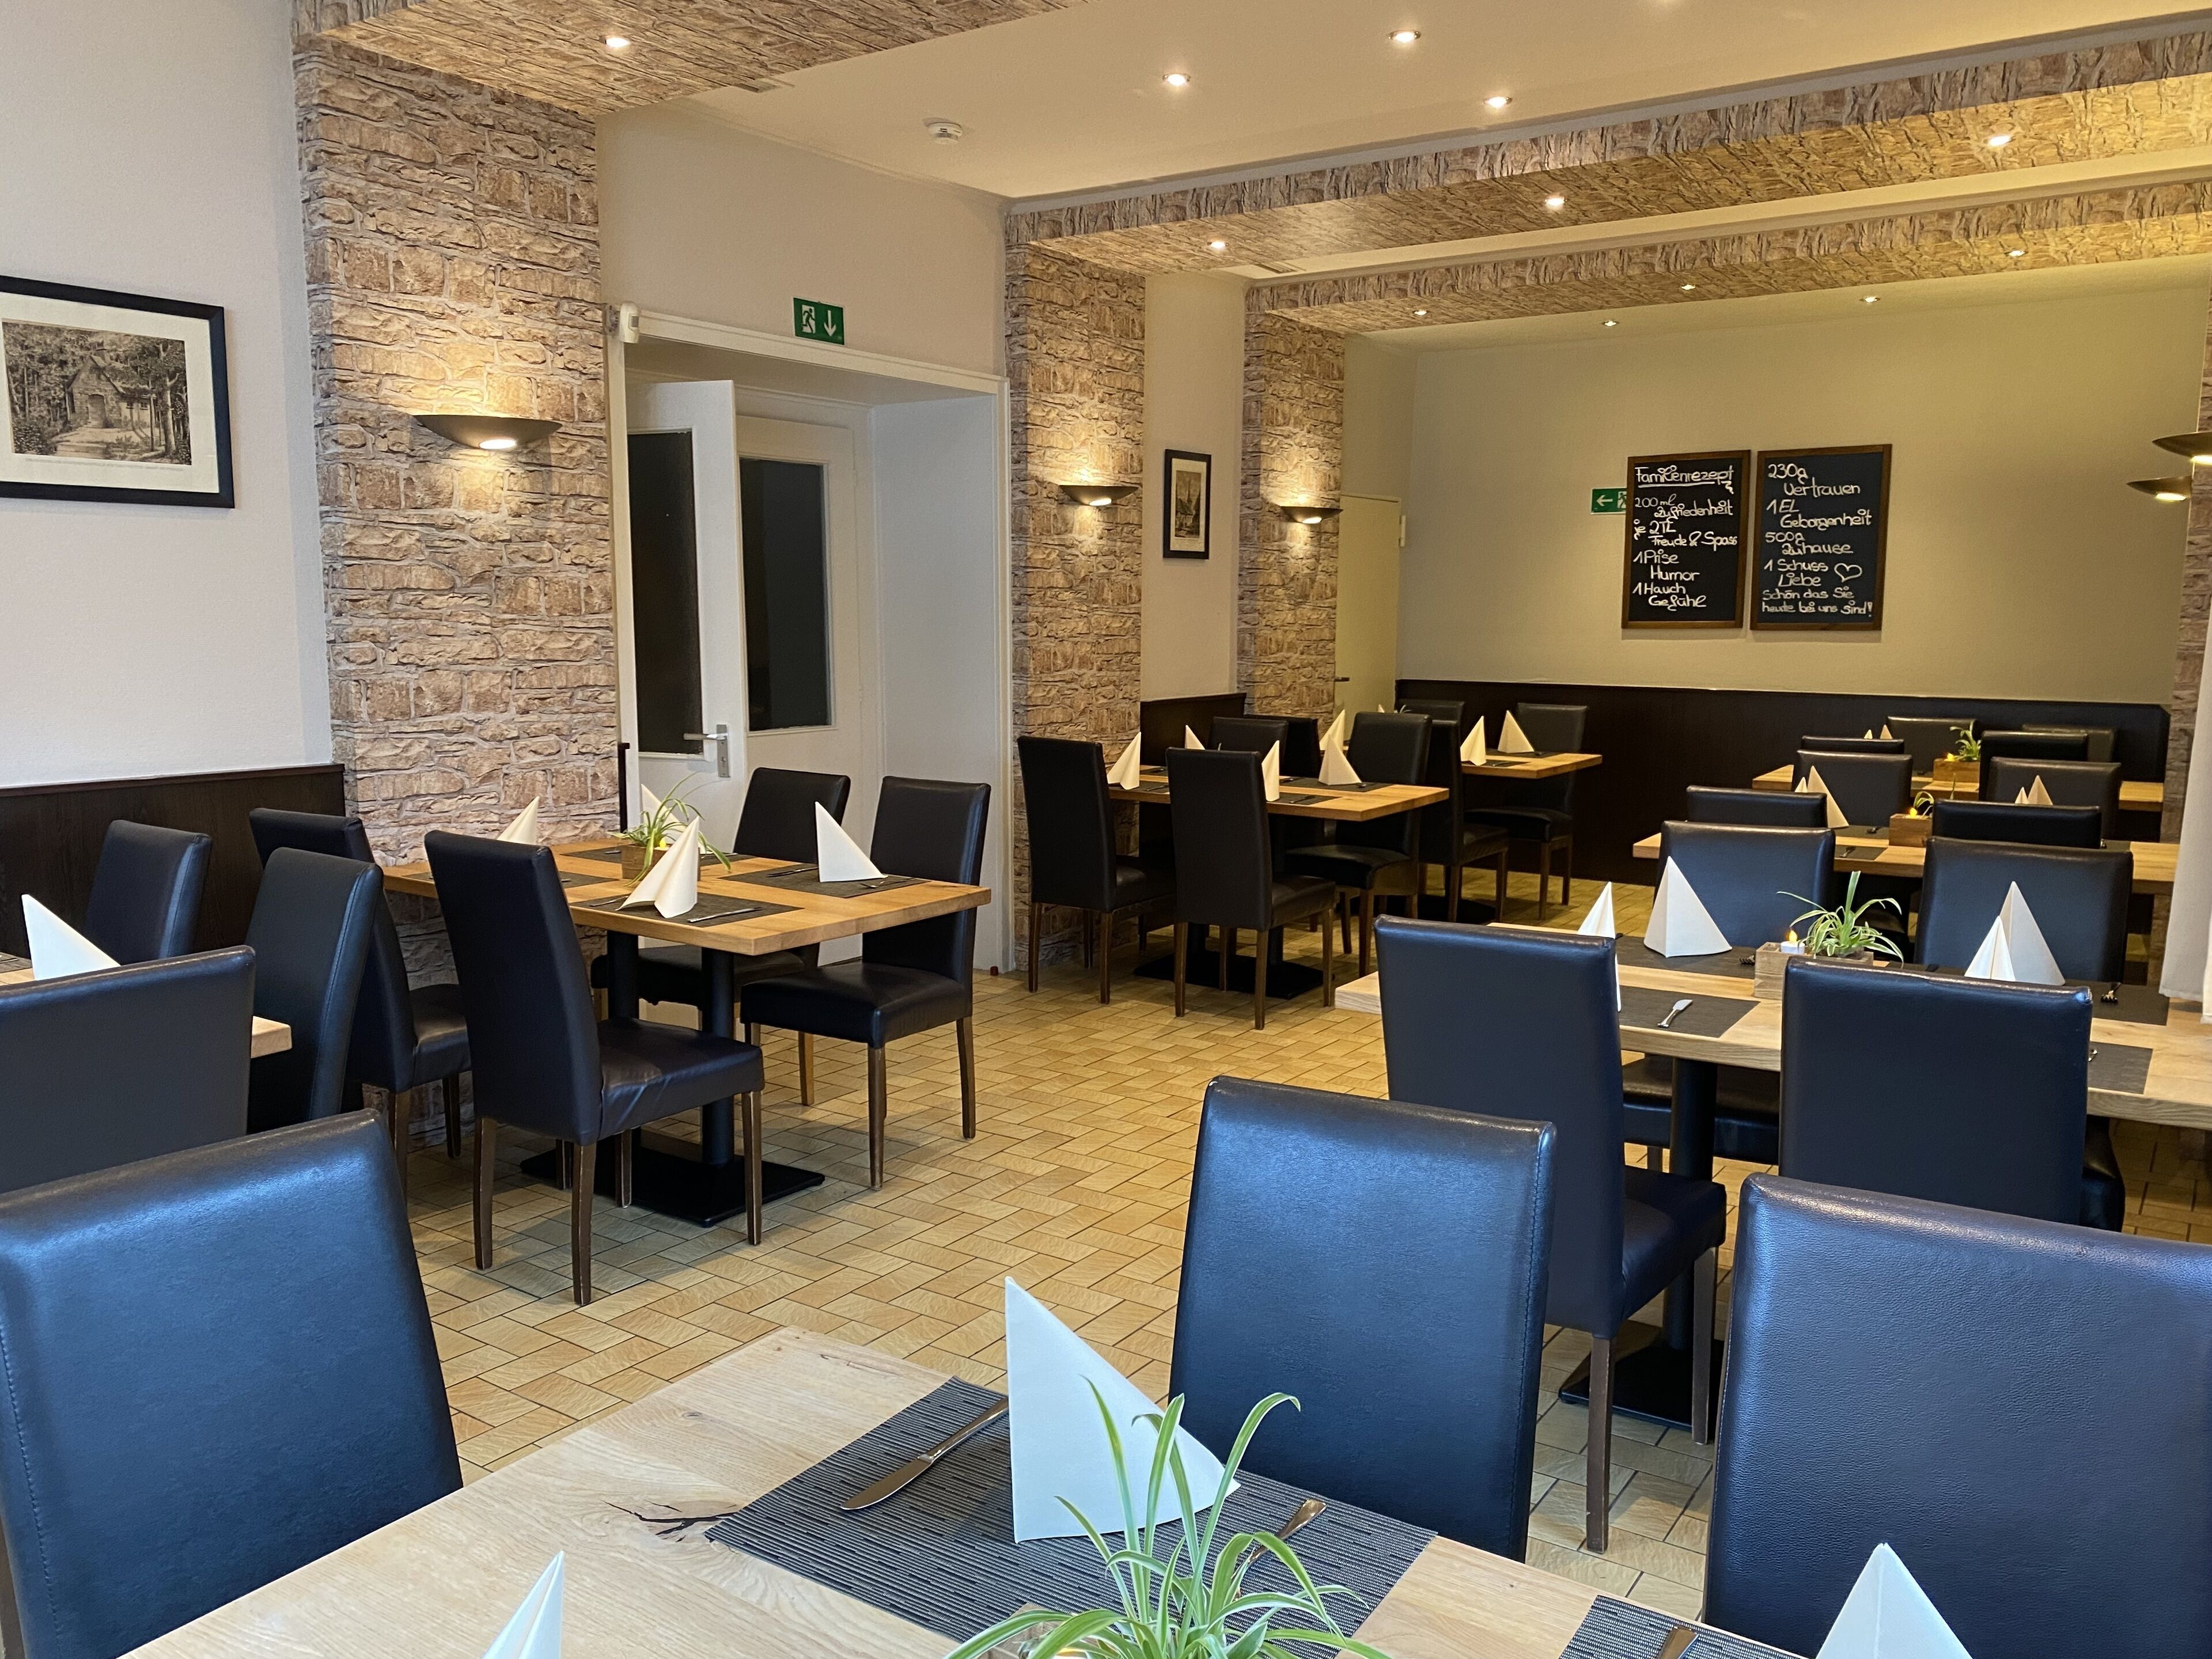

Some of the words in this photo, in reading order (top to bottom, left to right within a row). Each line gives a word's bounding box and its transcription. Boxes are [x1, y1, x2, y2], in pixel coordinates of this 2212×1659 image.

[1635, 465, 1734, 485] Familienrezept
[1768, 463, 1808, 484] 230g
[1635, 497, 1658, 507] 200
[1660, 493, 1676, 506] ml
[1654, 499, 1733, 519] Zufriedenheit
[1781, 509, 1872, 531] Geborgenheit
[1634, 519, 1646, 540] je
[1648, 534, 1687, 547] Freude
[1689, 531, 1702, 546] &
[1701, 531, 1737, 551] Spass
[1765, 532, 1805, 546] 500g
[1782, 543, 1853, 555] Zuhause
[1650, 565, 1700, 581] Humor
[1764, 559, 1772, 571] 1
[1778, 559, 1828, 571] Schuss
[1778, 573, 1821, 586] Liebe
[1804, 589, 1828, 599] das
[1833, 586, 1854, 599] Sie
[1649, 594, 1706, 611] Gefühl
[1762, 601, 1796, 612] heute
[1798, 601, 1816, 612] bei
